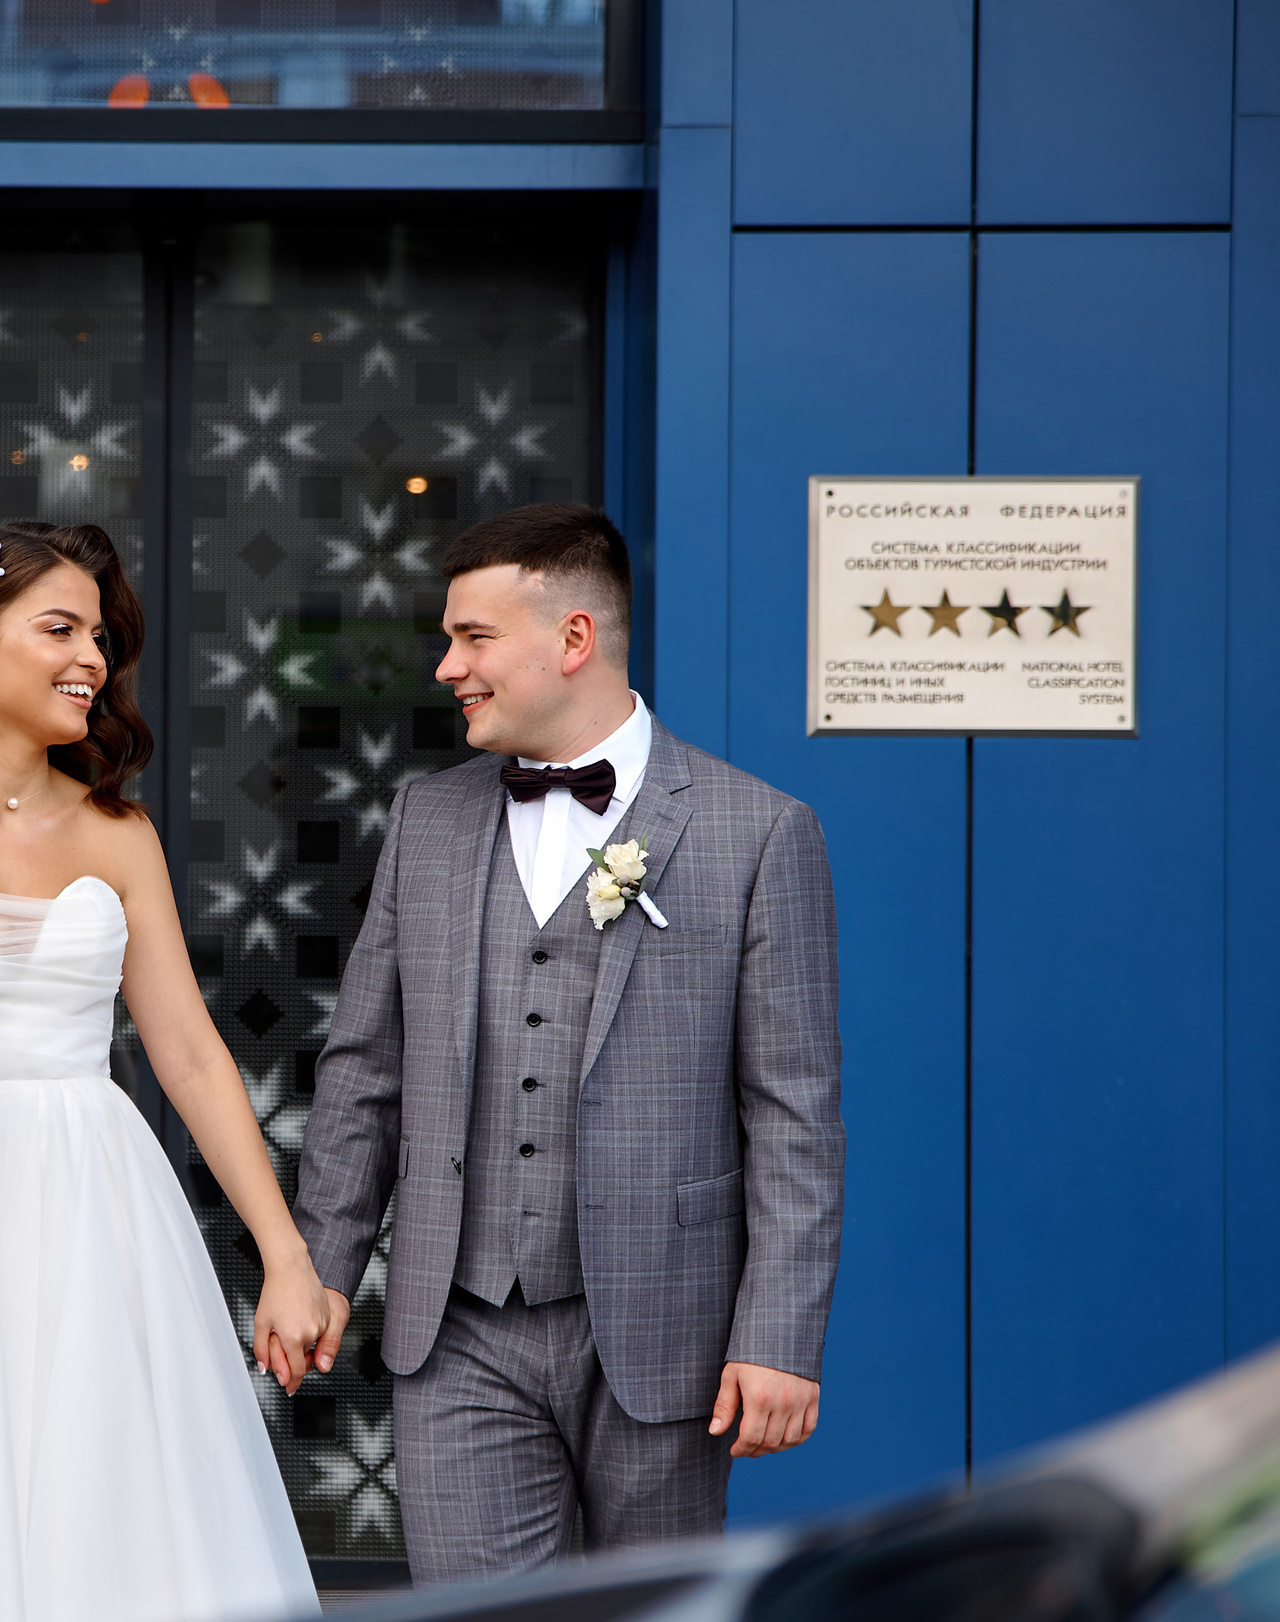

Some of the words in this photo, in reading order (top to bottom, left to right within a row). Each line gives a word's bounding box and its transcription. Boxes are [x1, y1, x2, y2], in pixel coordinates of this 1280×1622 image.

[826, 502, 971, 519] РОССИЙСКАЯ
[1000, 503, 1128, 520] ФЕДЕРАЦИЯ
[871, 541, 940, 555] СИСТЕМА
[946, 541, 1081, 556] КЛАССИФИКАЦИИ
[845, 557, 920, 571] ОБЪЕКТОВ
[924, 555, 1016, 572] ТУРИСТСКОЙ
[1021, 557, 1108, 572] ИНДУСТРИИ
[825, 660, 885, 673] СИСТЕМА
[890, 660, 1005, 674] КЛАССИФИКАЦИИ
[1022, 660, 1085, 673] NATIONAL
[1087, 660, 1125, 673] HOTEL
[825, 676, 891, 689] ГОСТИНИЦ
[896, 676, 906, 688] И
[910, 676, 945, 688] ИНЫХ
[1027, 676, 1125, 689] CLASSIFICATION
[825, 692, 877, 705] СРЕДСТВ
[881, 692, 965, 705] РАЗМЕЩЕНИЯ
[1079, 693, 1125, 705] SYSTEM
